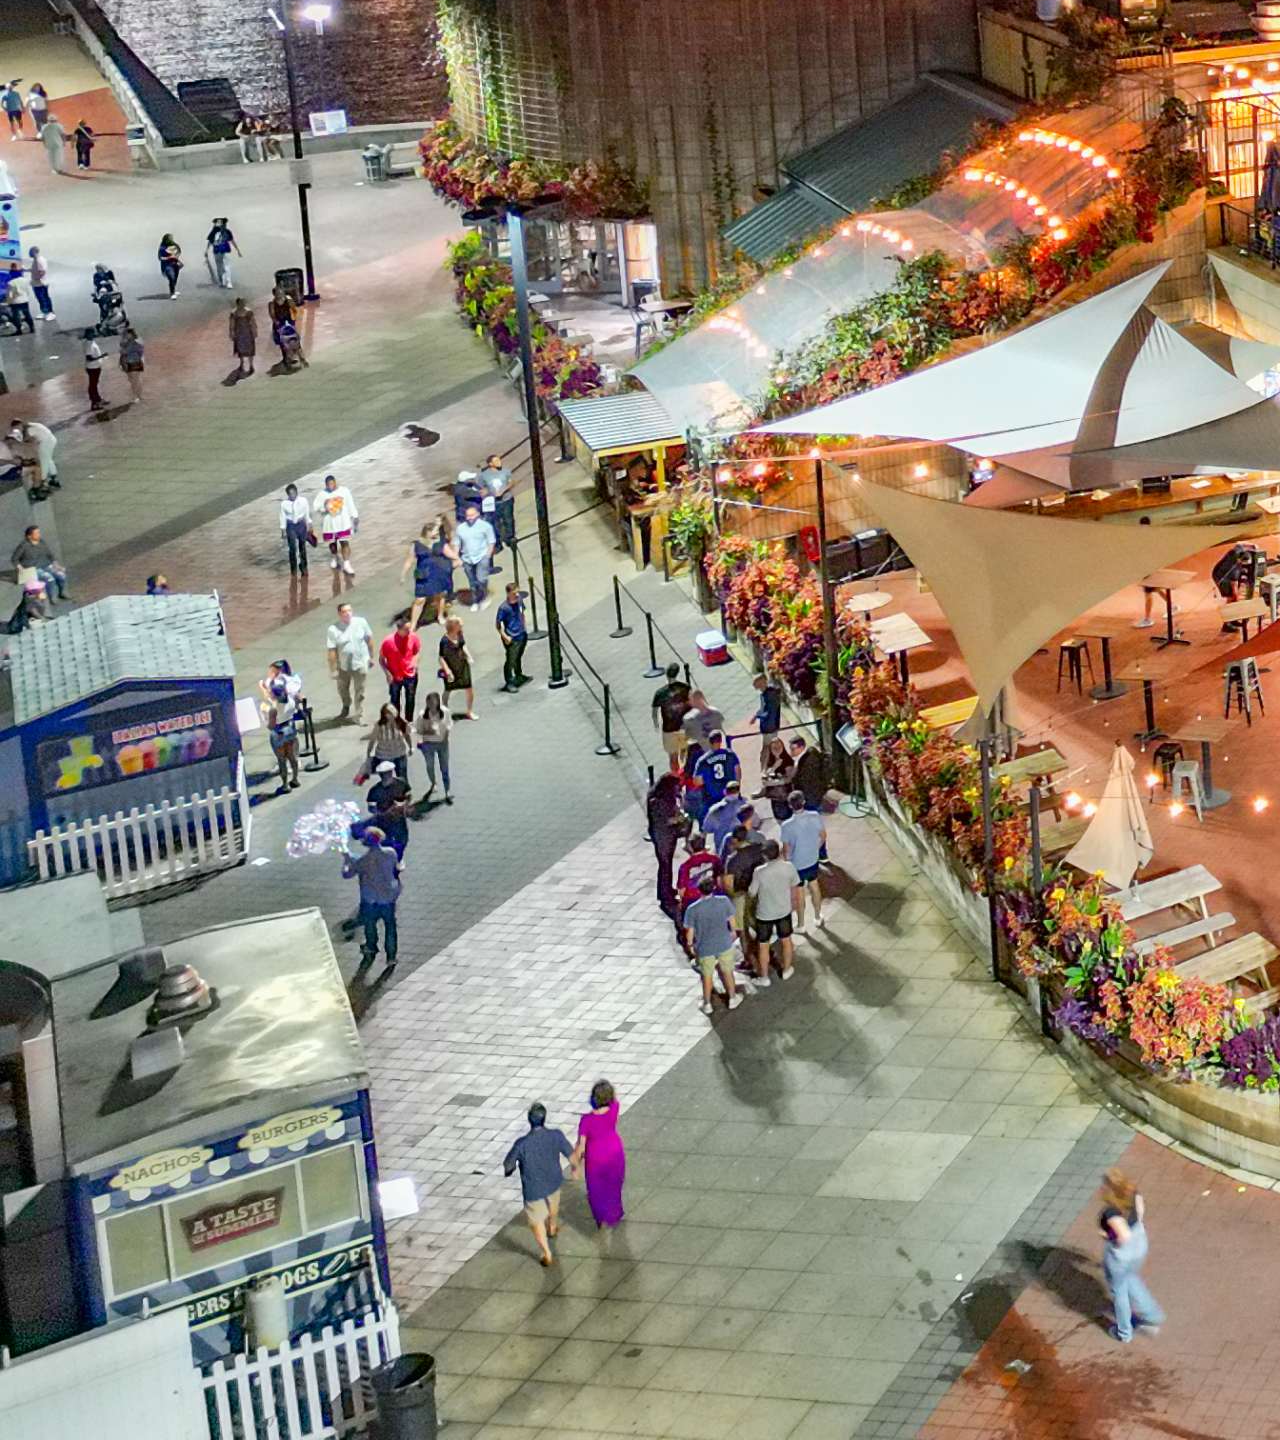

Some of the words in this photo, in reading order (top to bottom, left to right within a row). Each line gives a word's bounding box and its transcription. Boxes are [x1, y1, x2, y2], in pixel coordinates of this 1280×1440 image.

[713, 763, 725, 779] 3
[252, 1111, 330, 1145] BURGERS
[123, 1151, 201, 1185] NACHOS
[192, 1219, 208, 1236] A
[208, 1196, 276, 1228] TASTE
[187, 1291, 231, 1321] GERS
[280, 1261, 320, 1289] OGS
